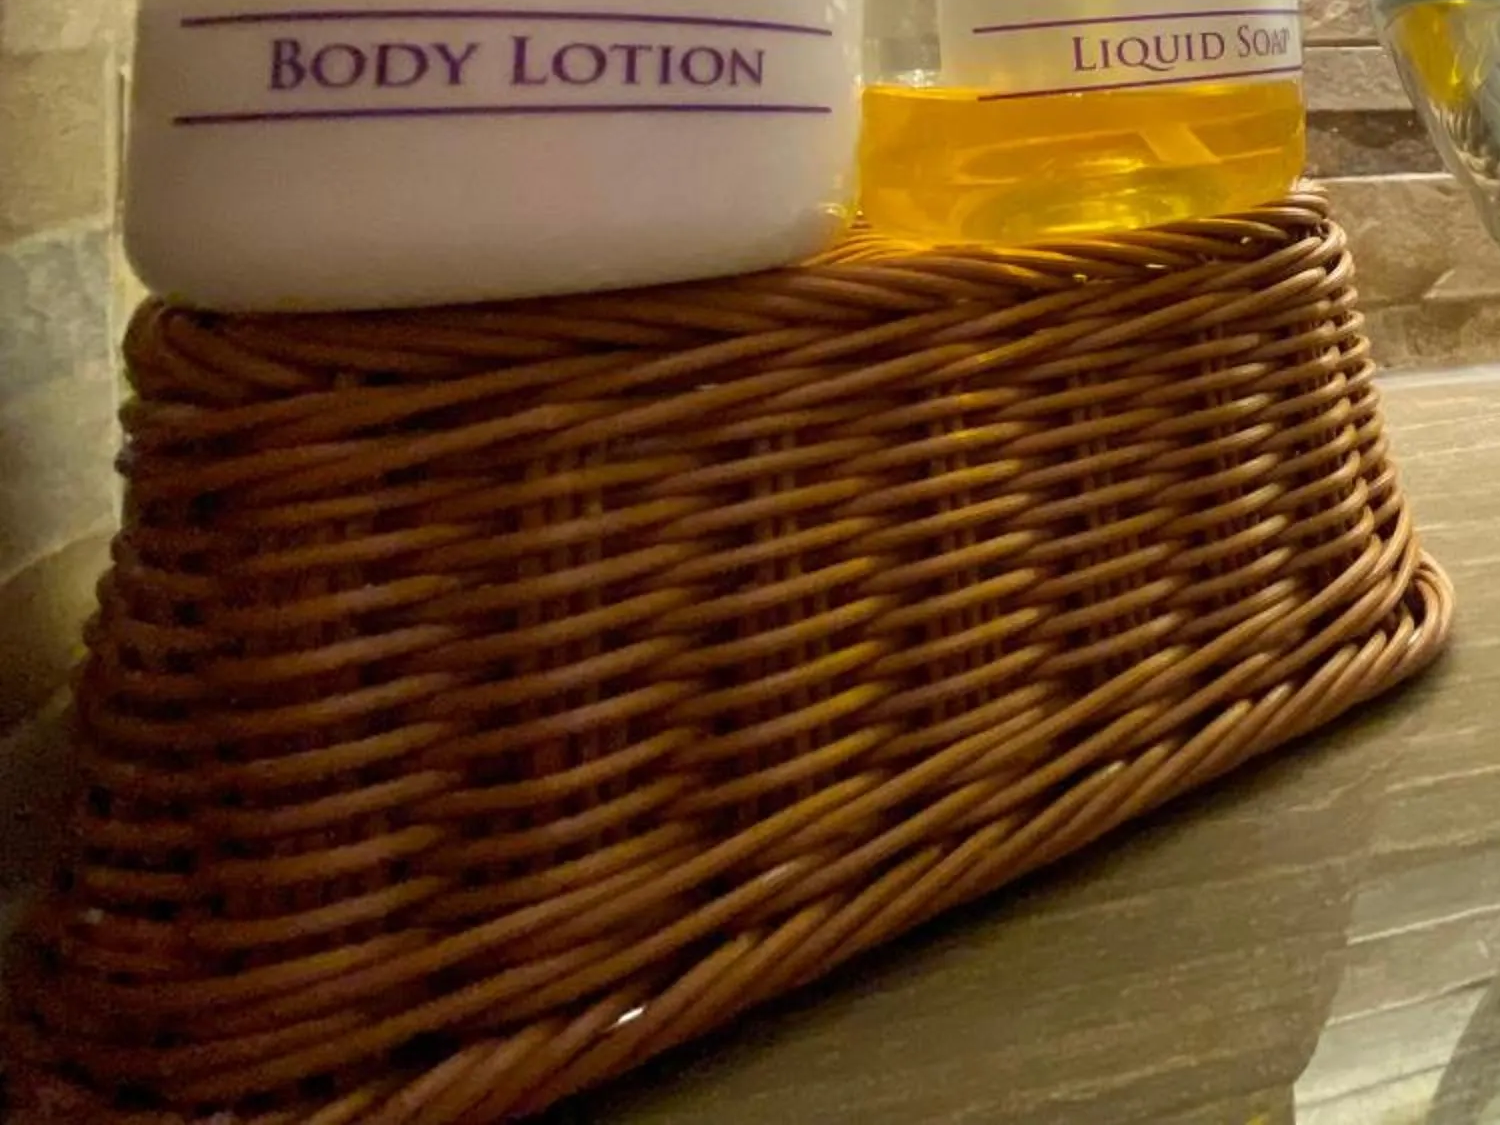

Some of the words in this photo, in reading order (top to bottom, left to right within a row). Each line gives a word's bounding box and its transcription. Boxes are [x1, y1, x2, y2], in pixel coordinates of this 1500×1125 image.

[268, 38, 480, 91] BODY
[509, 34, 767, 88] LOTION
[1072, 31, 1226, 73] LIQUID
